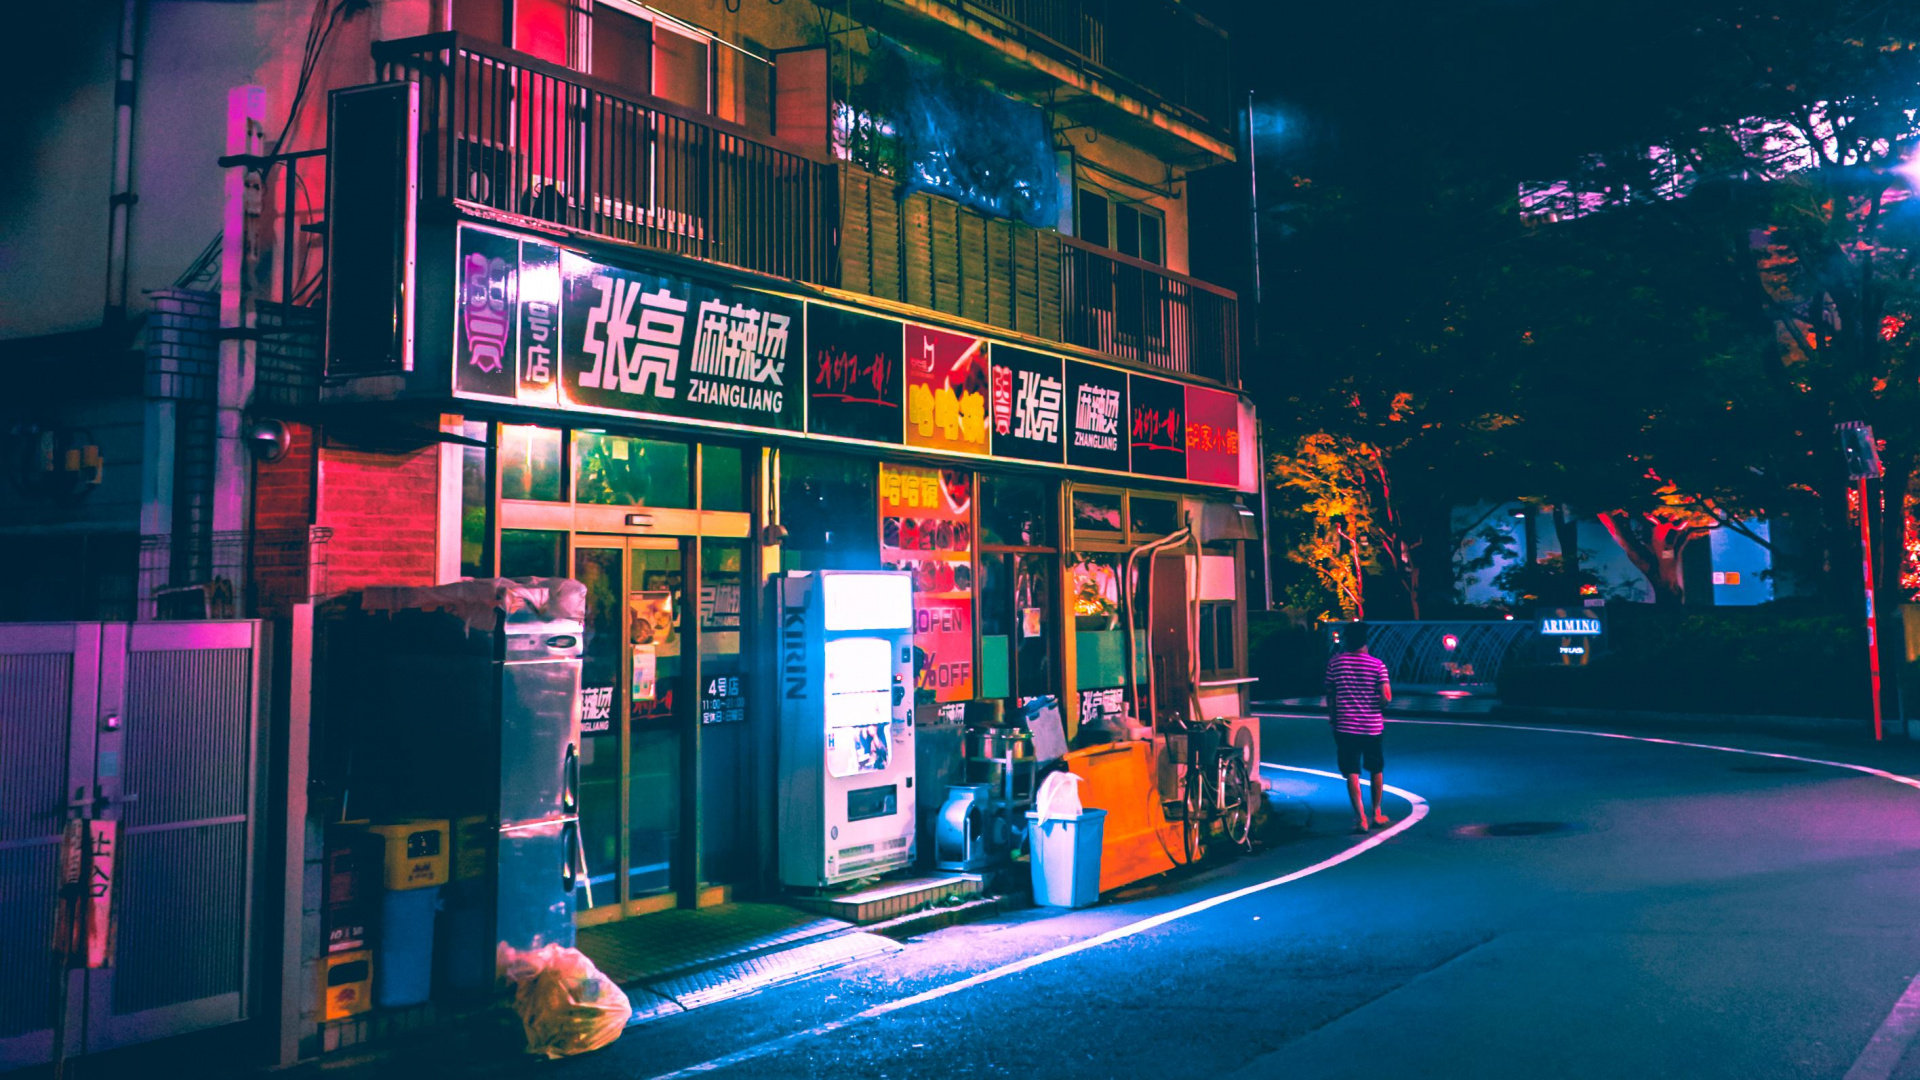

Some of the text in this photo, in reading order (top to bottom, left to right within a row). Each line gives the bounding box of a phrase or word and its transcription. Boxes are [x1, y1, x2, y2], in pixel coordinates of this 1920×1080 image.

[578, 276, 791, 399] 张亮 麻辣烫
[687, 379, 783, 413] ZHANGLIANG
[1014, 370, 1120, 443] 张亮 麻辣烫
[1074, 431, 1118, 451] ZHANGLIANG
[914, 607, 963, 633] OPEN
[1542, 618, 1601, 633] ARIMINO
[784, 590, 808, 700] KIRIN
[708, 677, 740, 698] 4号店
